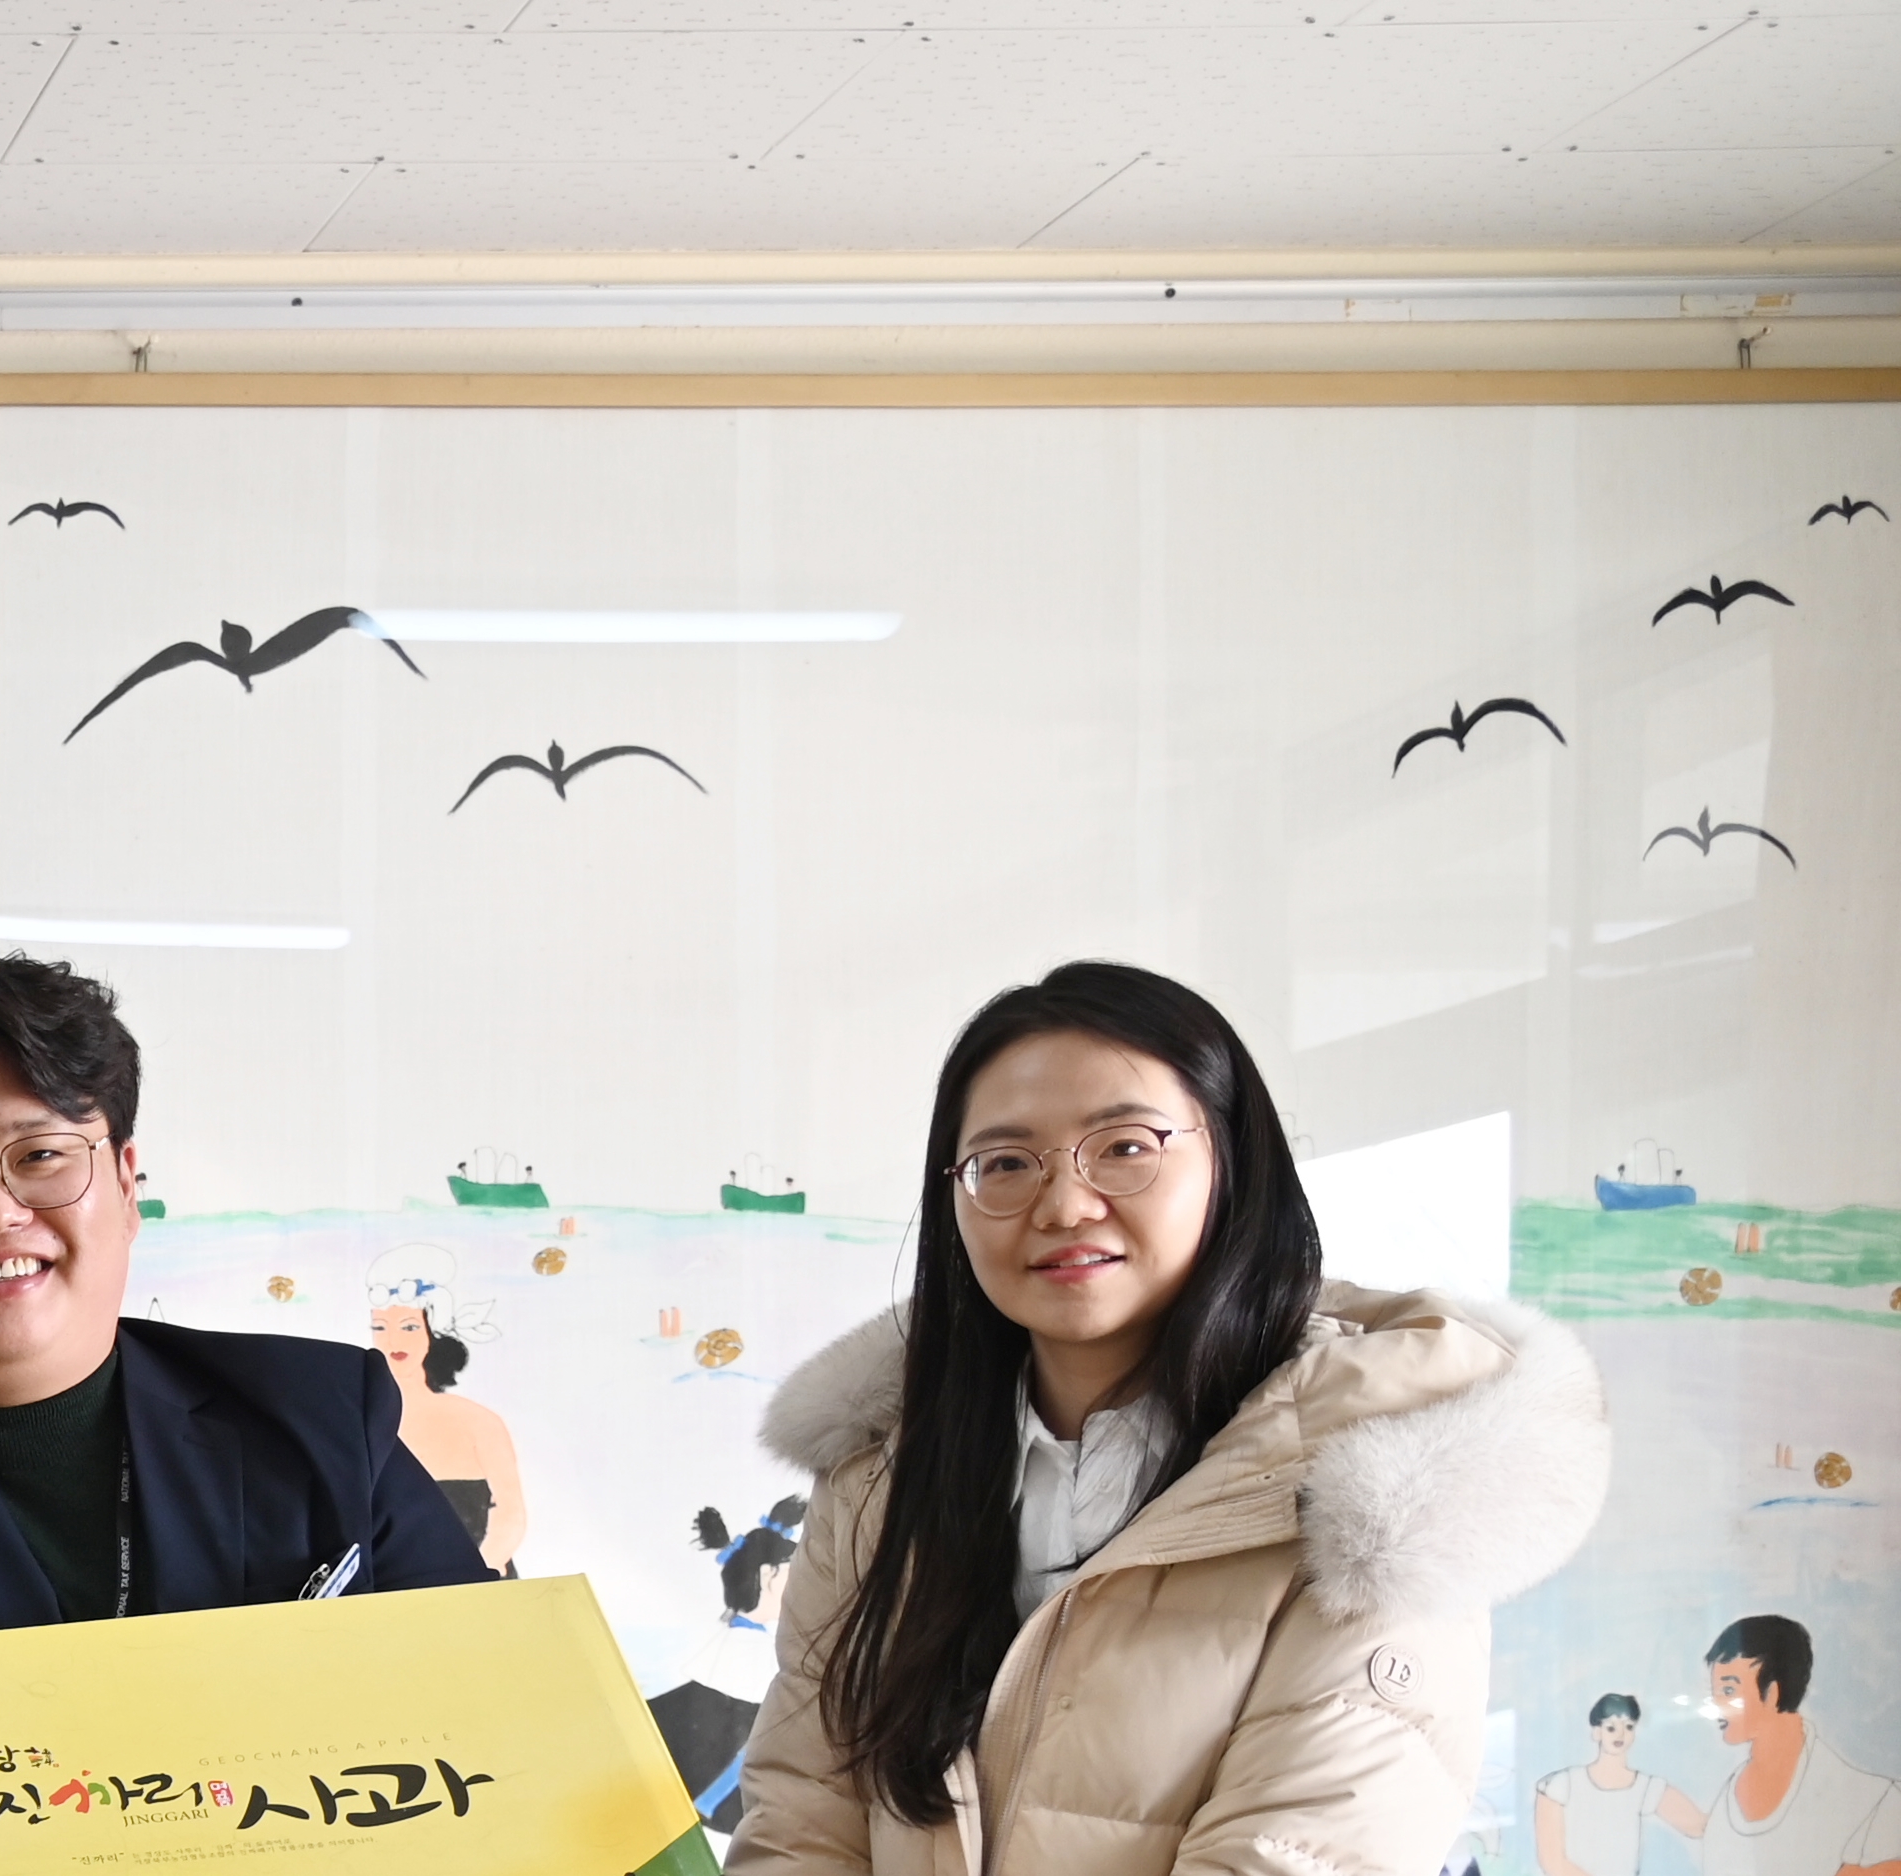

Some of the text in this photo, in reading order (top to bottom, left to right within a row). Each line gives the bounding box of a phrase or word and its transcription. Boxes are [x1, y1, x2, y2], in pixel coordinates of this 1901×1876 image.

[119, 1536, 130, 1567] SERVICE
[120, 1568, 130, 1589] TAX
[198, 1731, 452, 1767] GEOCHANG APPLE
[236, 1758, 495, 1830] 사과
[122, 1808, 210, 1828] JINGGARI
